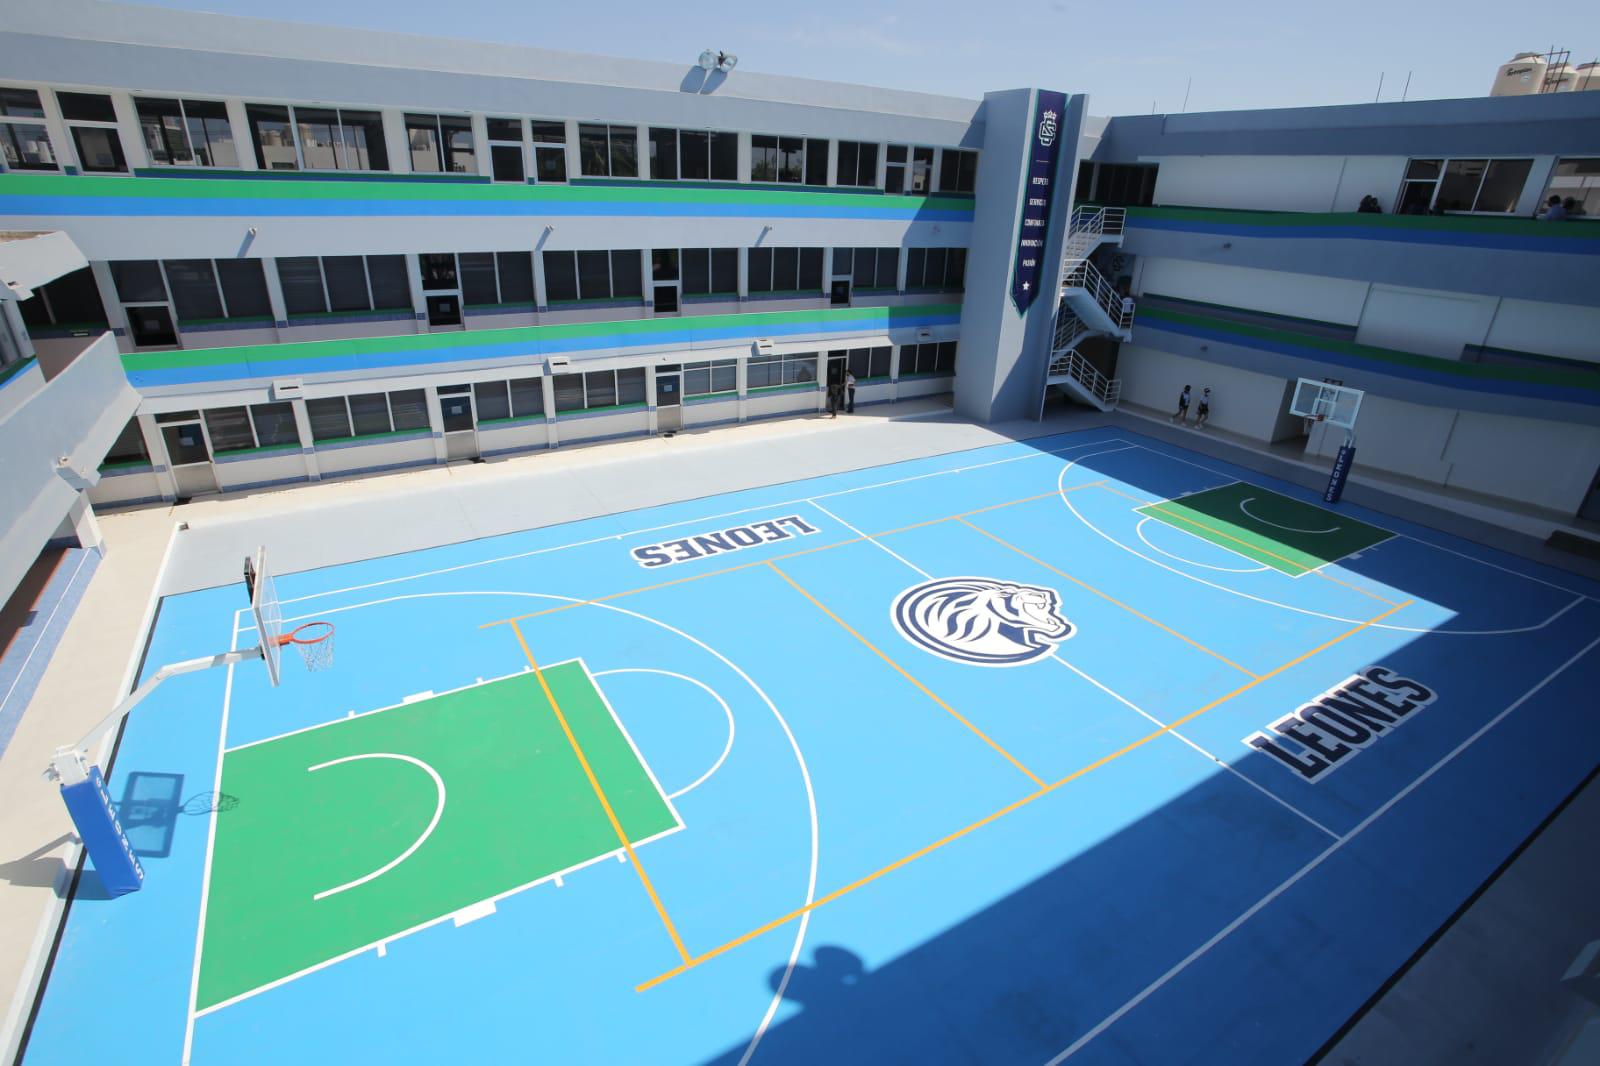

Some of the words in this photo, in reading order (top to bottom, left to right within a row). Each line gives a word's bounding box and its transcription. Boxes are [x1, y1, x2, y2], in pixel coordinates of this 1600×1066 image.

[1325, 456, 1344, 501] LEONES
[631, 514, 819, 568] LEONES
[1243, 666, 1436, 783] LEONES
